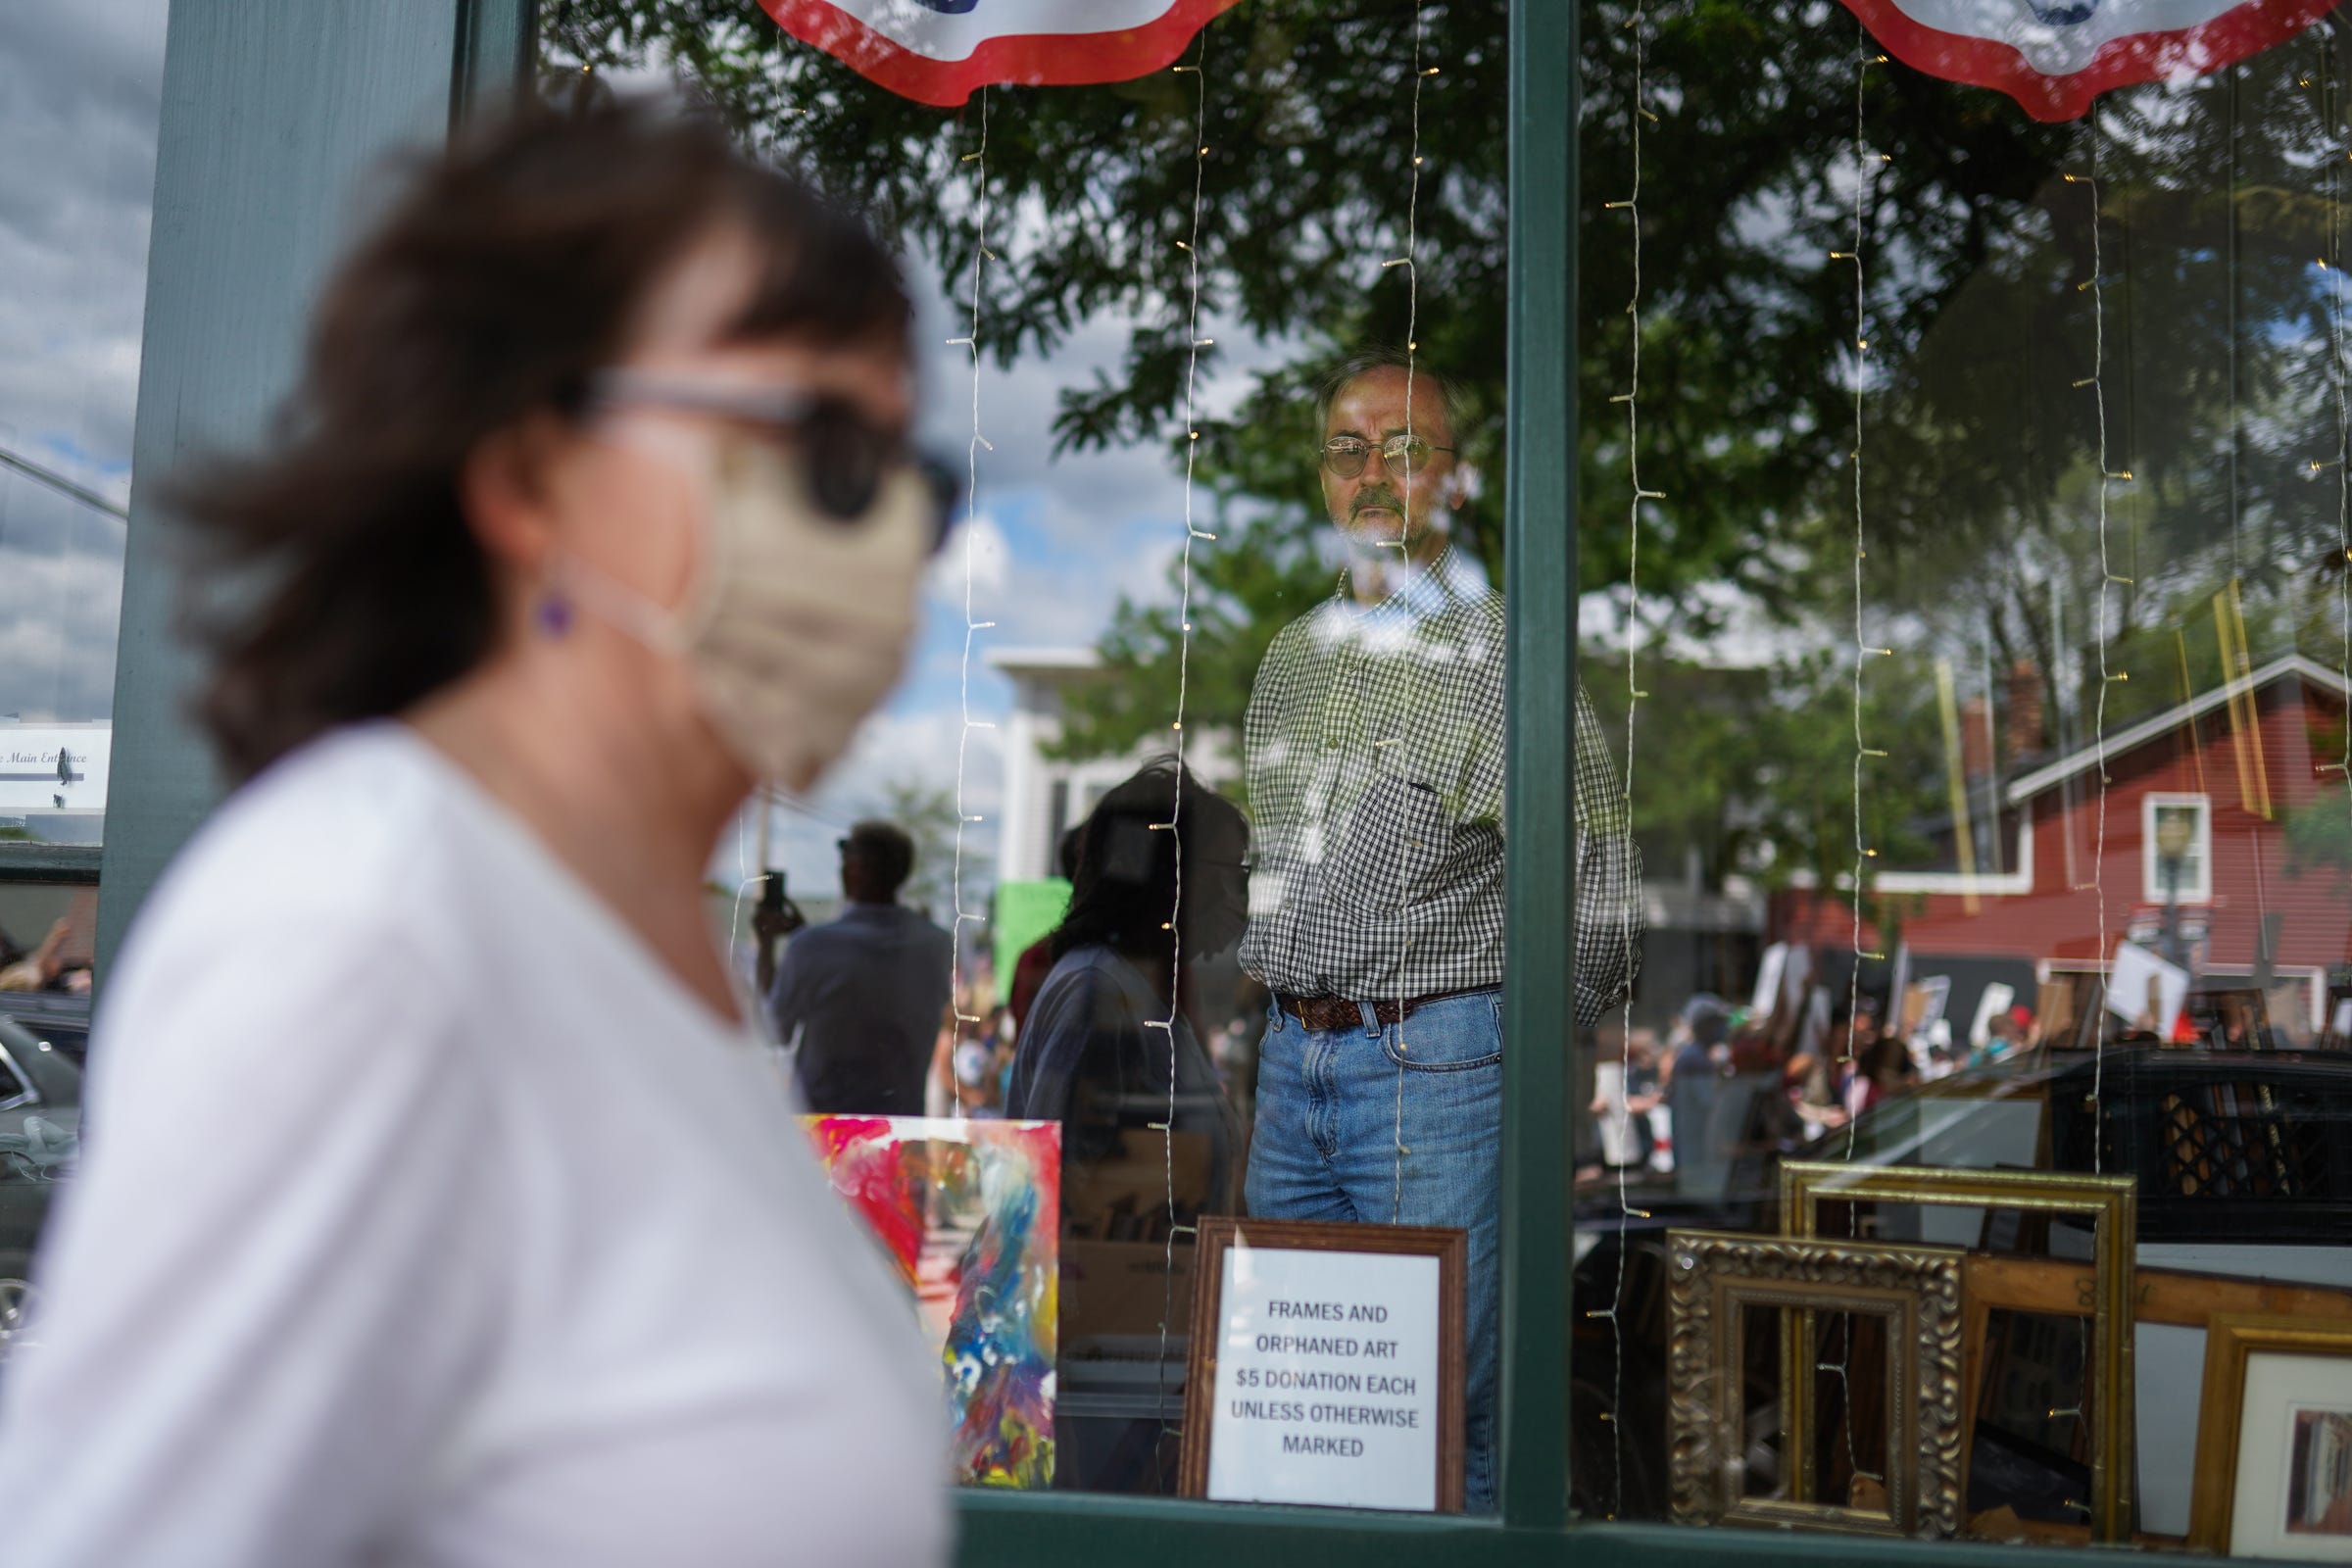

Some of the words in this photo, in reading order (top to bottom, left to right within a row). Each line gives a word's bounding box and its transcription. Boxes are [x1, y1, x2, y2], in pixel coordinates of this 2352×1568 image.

[7, 752, 37, 763] Main
[40, 752, 87, 763] Entance
[1268, 1299, 1344, 1321] FRAMES
[1348, 1304, 1389, 1323] AND
[1256, 1334, 1359, 1357] ORPHANED
[1363, 1340, 1399, 1360] ART
[1236, 1368, 1260, 1389] $5
[1264, 1370, 1361, 1393] DONATION
[1366, 1376, 1417, 1396] EACH
[1231, 1400, 1304, 1422] UNLESS
[1310, 1405, 1420, 1429] OTHERWISE
[1282, 1436, 1364, 1457] MARKED
